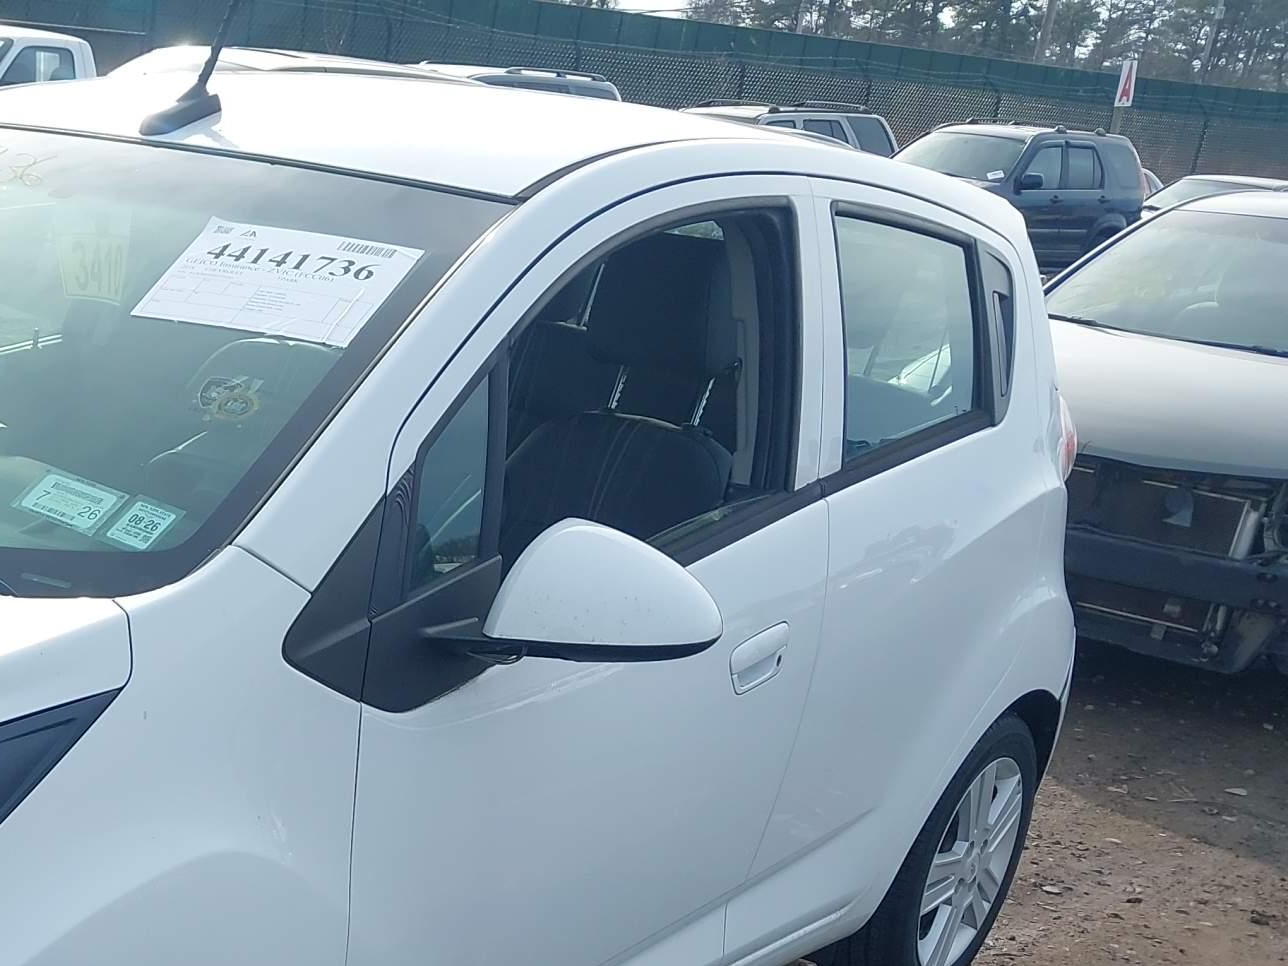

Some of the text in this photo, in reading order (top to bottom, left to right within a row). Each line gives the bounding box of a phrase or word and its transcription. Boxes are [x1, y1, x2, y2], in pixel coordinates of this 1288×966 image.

[1119, 61, 1134, 102] A
[206, 242, 375, 281] 44141736
[36, 489, 102, 521] 7 26
